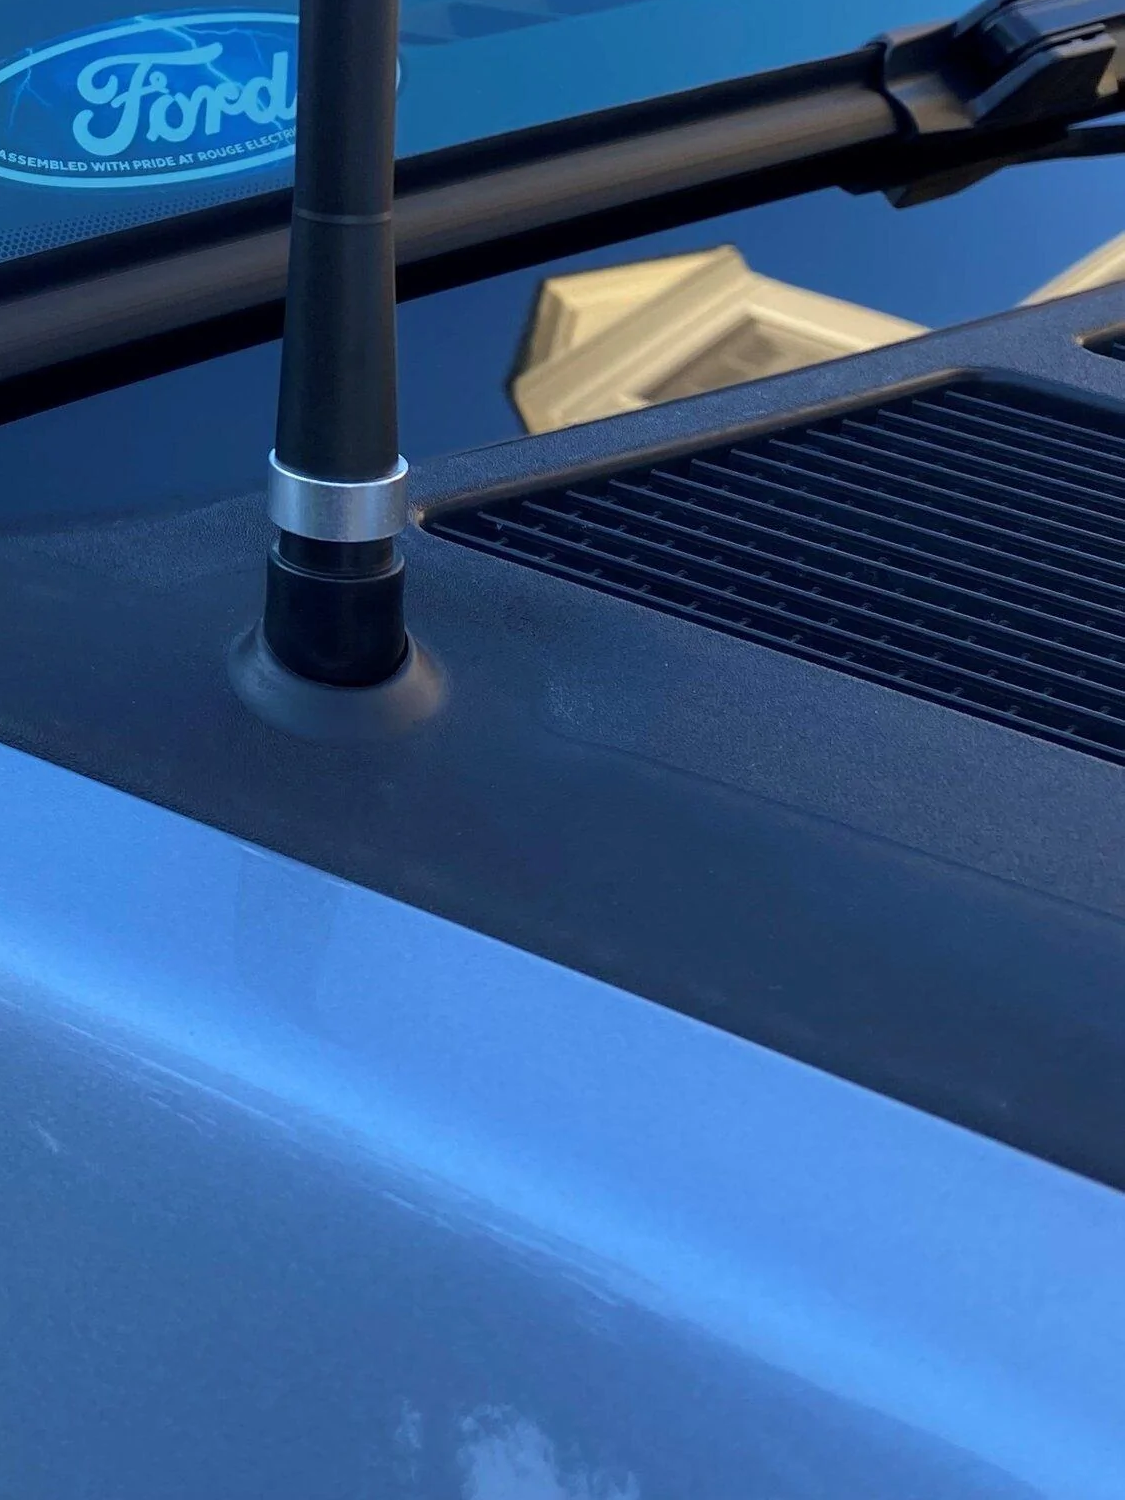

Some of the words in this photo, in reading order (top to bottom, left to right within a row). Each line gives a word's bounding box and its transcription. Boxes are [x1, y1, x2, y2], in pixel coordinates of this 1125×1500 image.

[73, 42, 296, 156] Ford
[90, 160, 131, 172] WITH
[133, 157, 176, 170] PRIDE
[178, 154, 194, 166] AT
[198, 143, 245, 161] ROUGE
